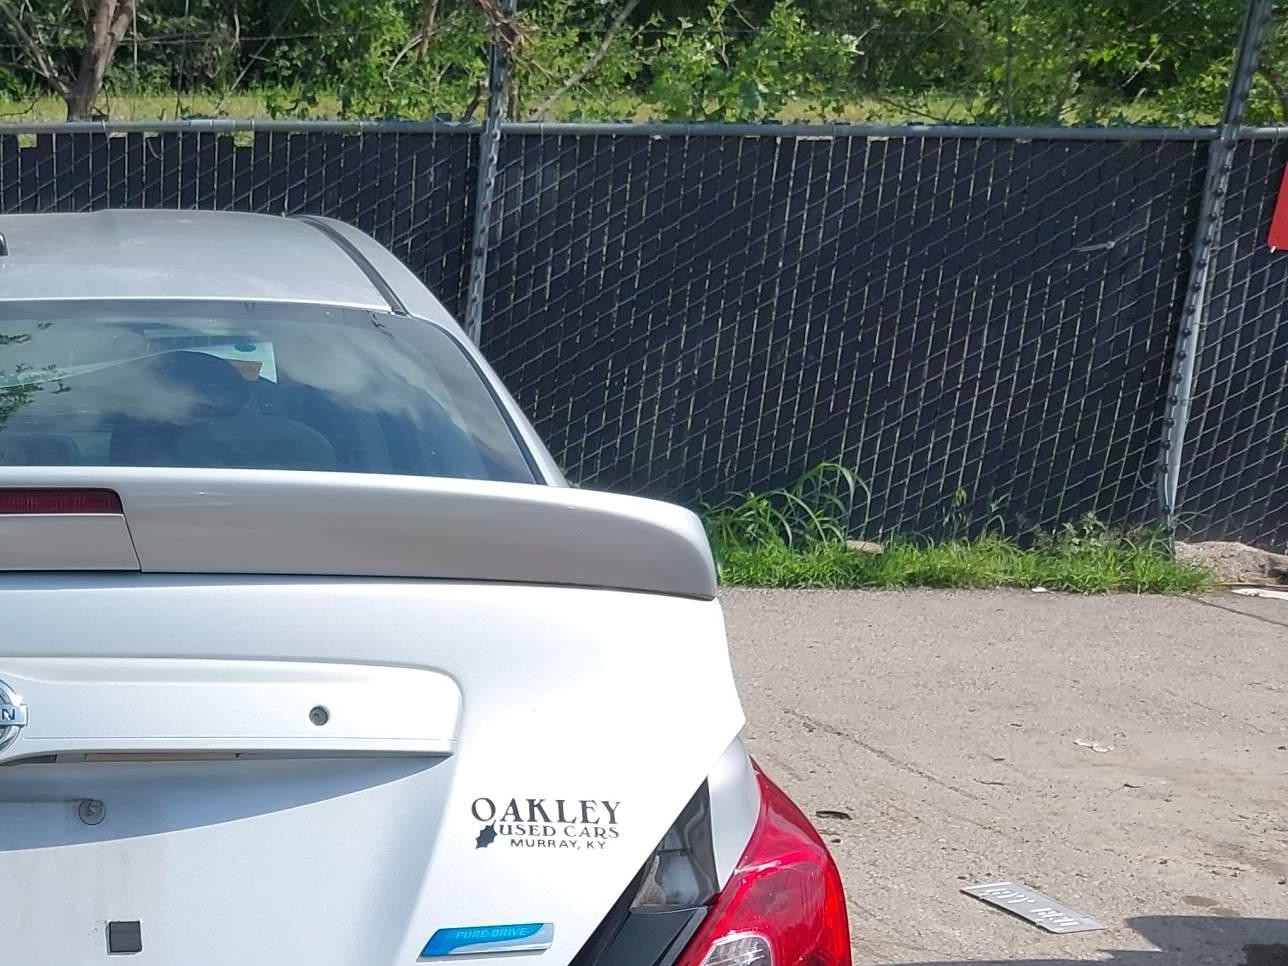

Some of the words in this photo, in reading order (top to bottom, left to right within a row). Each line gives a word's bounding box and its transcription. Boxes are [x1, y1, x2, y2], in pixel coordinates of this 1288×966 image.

[471, 797, 621, 824] OAKLEY
[499, 824, 556, 836] USED
[564, 826, 619, 839] CARS
[510, 839, 581, 850] MURRAY,
[586, 841, 606, 849] KY
